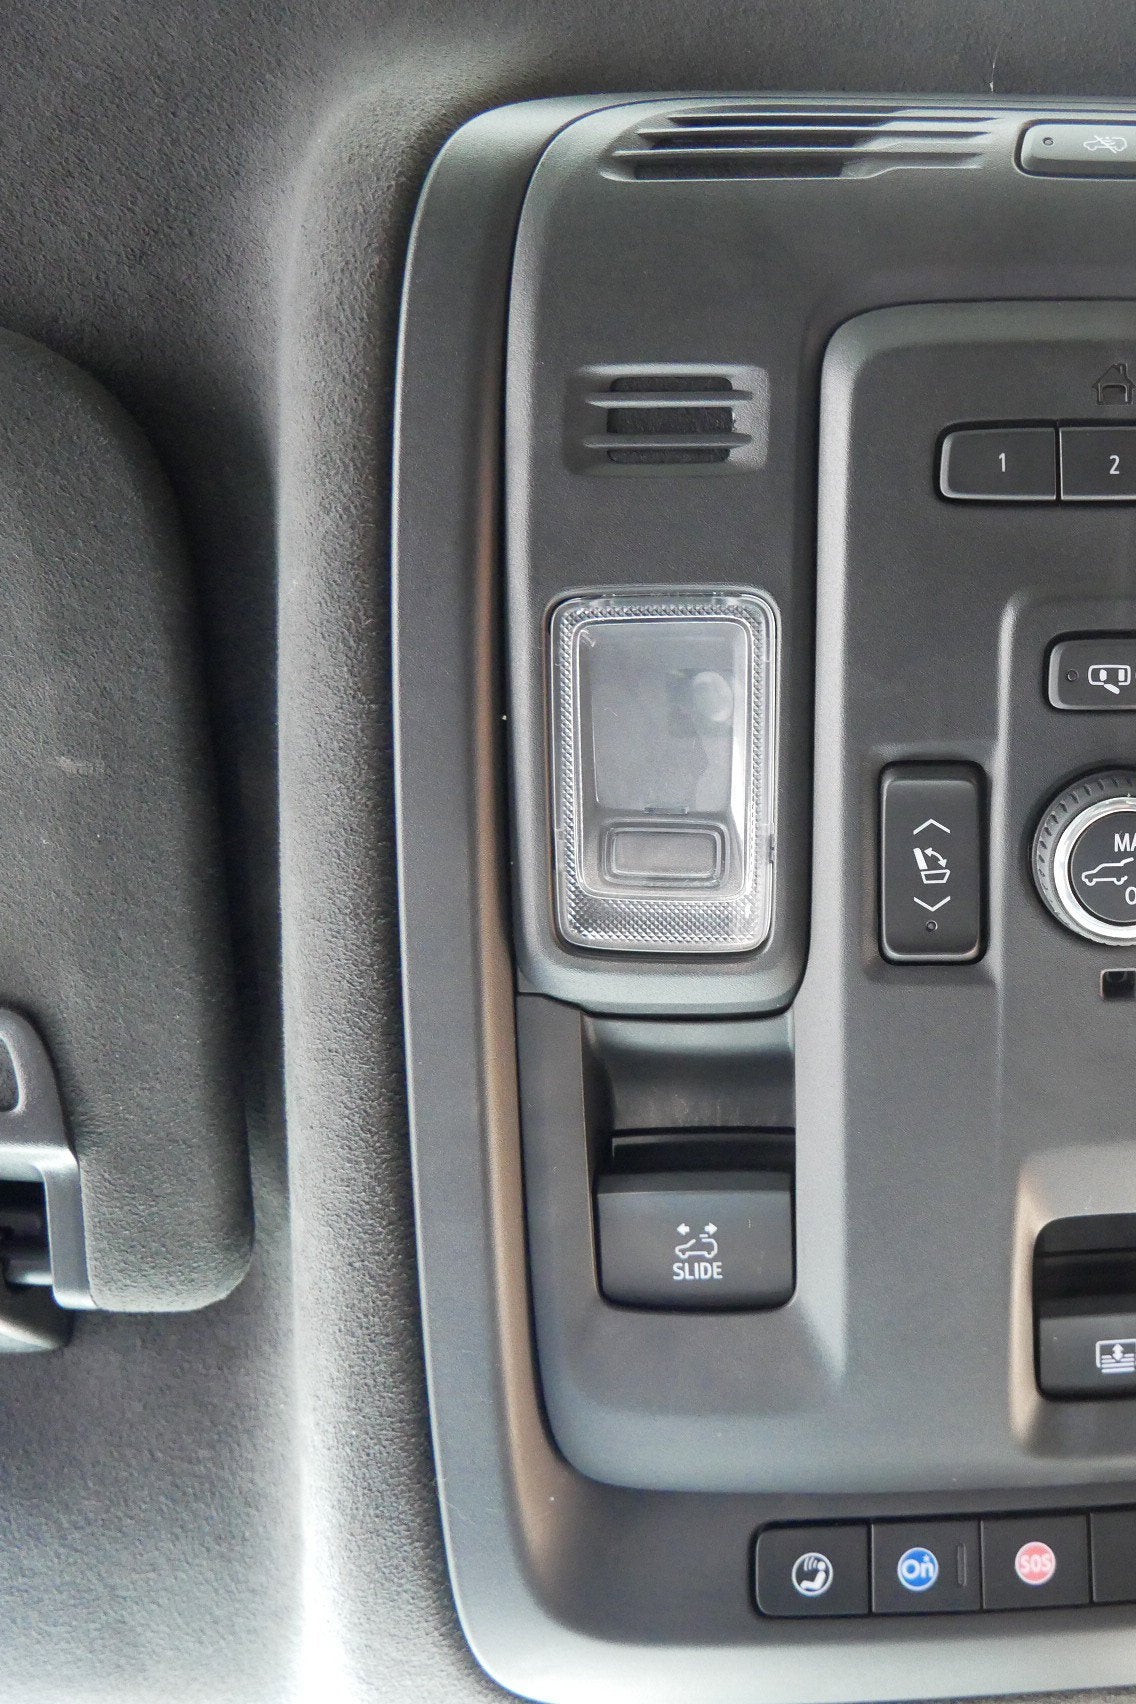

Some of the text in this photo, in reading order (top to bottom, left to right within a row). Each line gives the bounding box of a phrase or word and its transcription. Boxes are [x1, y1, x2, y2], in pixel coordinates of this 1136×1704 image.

[998, 452, 1007, 472] 1
[1109, 455, 1120, 475] 2
[672, 1261, 724, 1280] SLIDE
[1019, 1553, 1051, 1574] SOS
